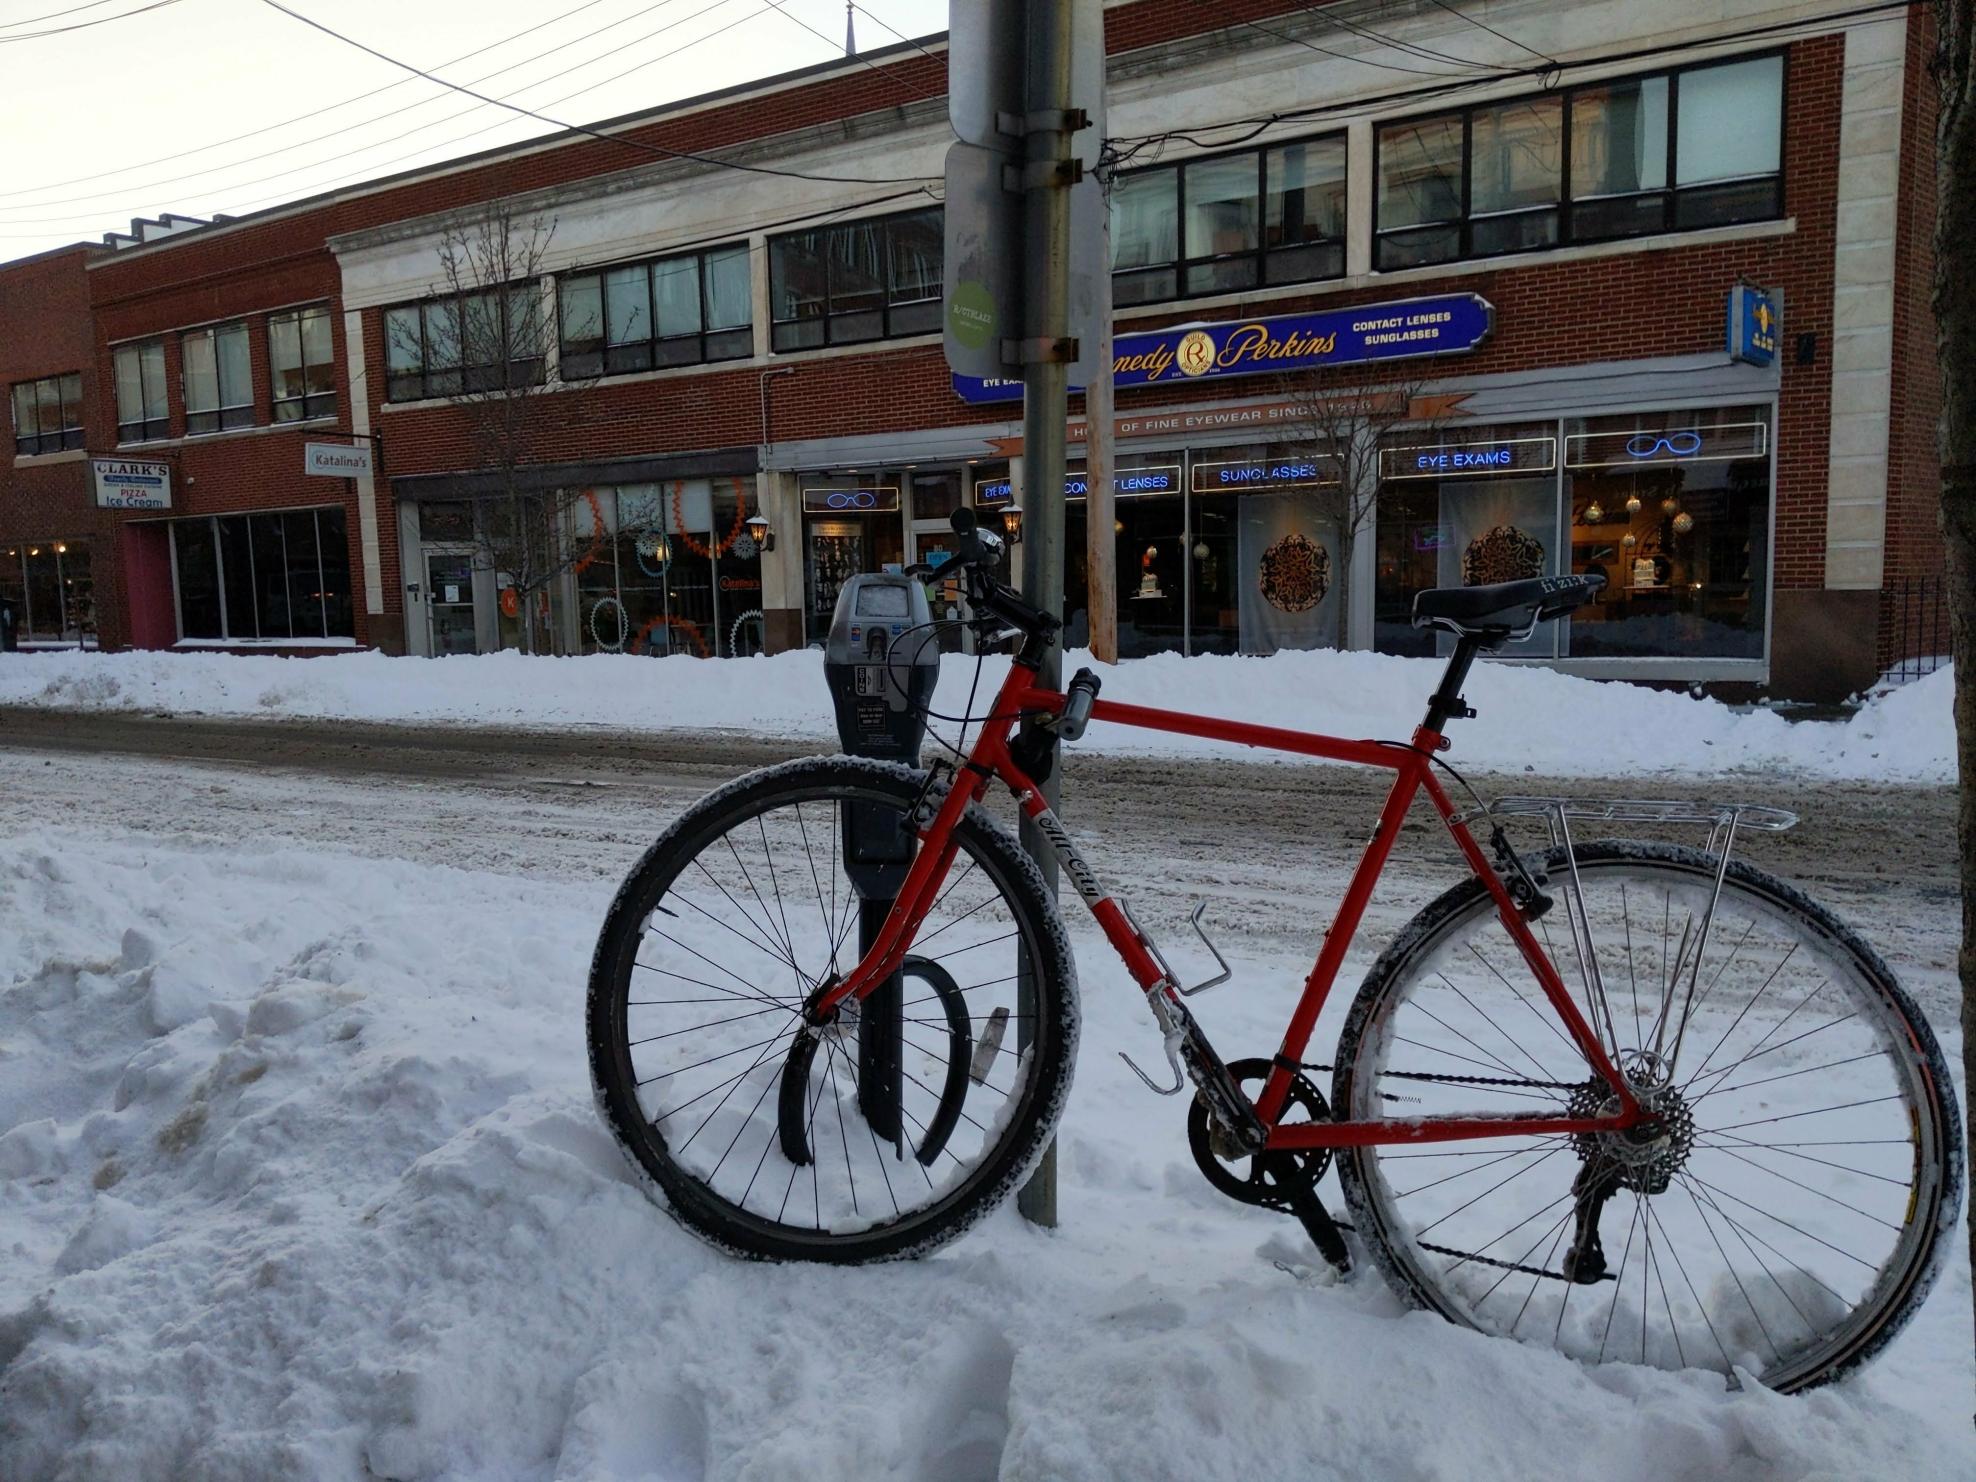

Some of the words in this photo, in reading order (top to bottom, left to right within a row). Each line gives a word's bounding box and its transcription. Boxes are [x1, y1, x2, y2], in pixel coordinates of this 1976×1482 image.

[1353, 317, 1404, 332] CONTACT
[1406, 312, 1452, 326] LENSES
[1186, 333, 1206, 343] GUILD
[1365, 328, 1439, 345] SUNGLASSES
[1113, 343, 1176, 381] nedy
[1217, 324, 1337, 367] Perkins
[983, 379, 1001, 388] EYE
[1121, 422, 1140, 432] OF
[1146, 418, 1180, 430] FINE
[1185, 410, 1262, 427] EYEWEAR
[315, 454, 368, 468] Katalina's
[1418, 455, 1448, 468] EYE
[1453, 451, 1511, 467] EXAMS
[97, 462, 168, 476] CLARK'S
[1121, 476, 1169, 490] LENSES
[120, 488, 148, 498] PIZZA
[985, 487, 998, 498] EYE
[106, 496, 123, 507] Ice
[126, 497, 163, 508] Cream
[1038, 817, 1099, 897] All-City
